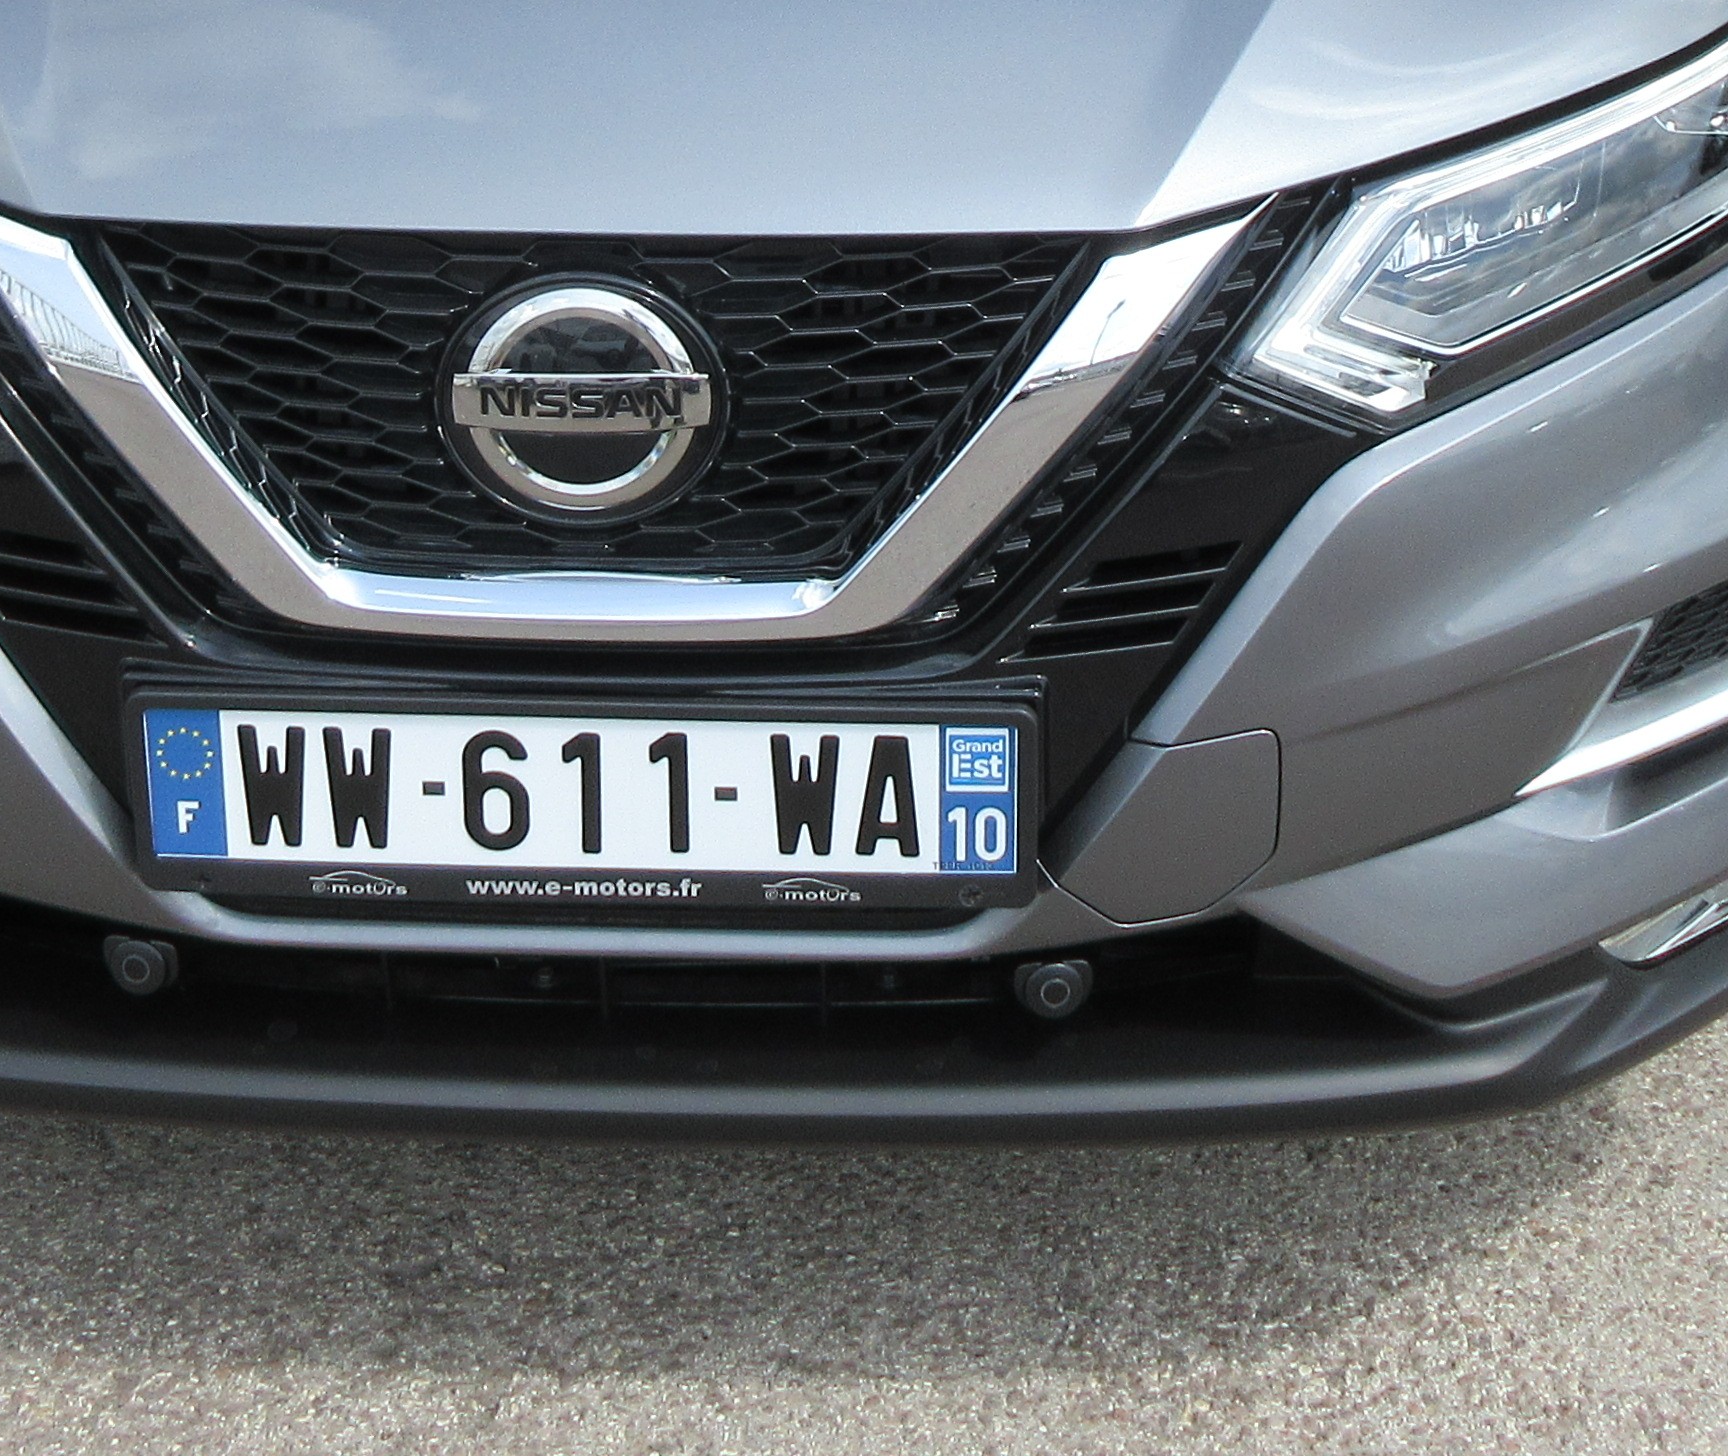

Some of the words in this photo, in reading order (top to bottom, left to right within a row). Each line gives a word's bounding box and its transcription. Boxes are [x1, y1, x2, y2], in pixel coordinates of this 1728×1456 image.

[478, 384, 683, 420] NISSAN
[951, 739, 1004, 753] Grand
[951, 754, 1004, 779] Est
[237, 723, 920, 857] WW-611-WA
[177, 800, 200, 834] F
[947, 806, 1007, 862] 10
[466, 877, 703, 898] www.e-motors.fr
